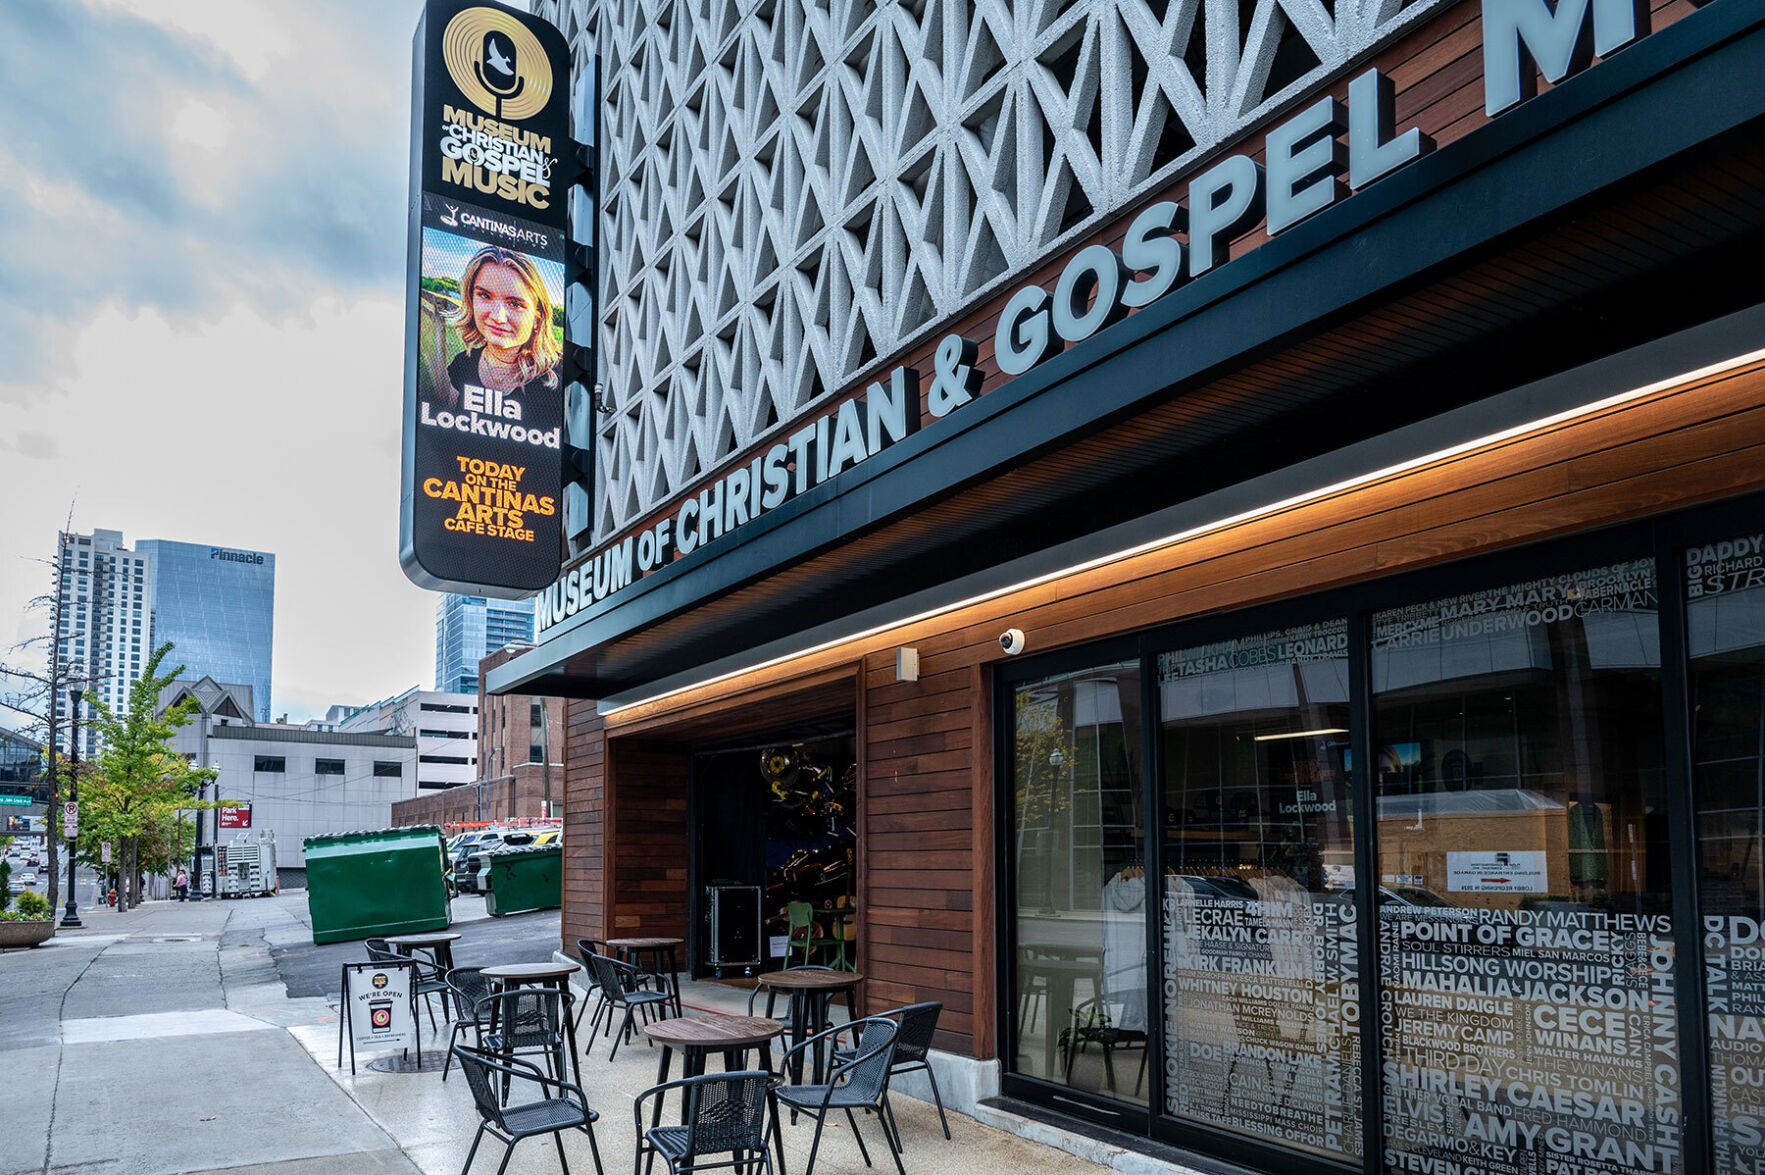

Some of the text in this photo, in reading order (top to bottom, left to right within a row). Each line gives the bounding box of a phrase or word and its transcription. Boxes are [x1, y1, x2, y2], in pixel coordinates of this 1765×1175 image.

[442, 104, 552, 153] MUSEUM
[449, 124, 544, 165] CHRISTIAN
[440, 136, 551, 188] GOSPEL
[442, 156, 551, 210] MUSIC
[535, 536, 633, 633] MUSEUM
[637, 518, 670, 571] OF
[676, 366, 907, 554] CHRISTIAN
[928, 334, 974, 418] &
[994, 67, 1420, 376] GOSPEL
[464, 384, 522, 421] Ella
[420, 401, 560, 449] Lockwood
[456, 455, 526, 481] TODAY
[423, 478, 555, 515] CANTINAS
[465, 474, 517, 491] ON THE
[456, 502, 524, 528] ARTS
[444, 518, 535, 542] CAFE STAGE
[211, 547, 264, 565] Pinnacle
[1686, 533, 1765, 566] DADDY
[1580, 568, 1651, 588] BROOKLYN
[1704, 555, 1763, 576] RICHARD
[1511, 566, 1609, 594] MIGHTY CLOUDS
[1580, 577, 1652, 600] TABERNACLE
[1687, 565, 1704, 598] BIG
[1440, 596, 1500, 619] MARY
[1505, 583, 1571, 608] MARY
[1574, 590, 1659, 618] CARMAN
[1371, 629, 1440, 651] CARRIE
[1441, 604, 1574, 640] UNDERWOOD
[1376, 616, 1440, 639] MERCYME
[1278, 633, 1348, 658] LEONARD
[1279, 800, 1337, 814] Lockwood
[1298, 790, 1318, 801] Ella
[1184, 908, 1244, 926] LECRAE
[1213, 899, 1244, 909] HARRIS
[1379, 905, 1478, 917] ANDREW PETERSON
[1395, 914, 1414, 922] ARE
[1184, 924, 1304, 945] JEKALYN CARR
[1326, 903, 1338, 960] SMITH
[1479, 908, 1672, 933] RANDY MATTHEWS
[1401, 921, 1610, 952] POINT OF GRACE
[1402, 940, 1511, 958] SOUL STIRRERS
[1221, 957, 1303, 979] FRANKLIN
[1313, 935, 1326, 995] BOBBY
[1392, 921, 1401, 989] RAINE NAOMI
[1402, 952, 1612, 985] HILLSONG WORSHIP
[1512, 948, 1611, 963] MIEL SAN MARCOS
[1610, 930, 1638, 989] RICKY SKAGGS
[1703, 916, 1729, 1013] DC TALK
[1338, 903, 1361, 1036] TOBYMAC
[1731, 971, 1740, 980] &
[359, 991, 381, 1001] WE'RE
[1178, 978, 1313, 1004] WHITNEY HOUSTON
[1379, 920, 1394, 1061] ANDRAE CROUCH
[1395, 990, 1514, 1016] LAUREN DAIGLE
[1402, 970, 1650, 1012] MAHALIA JACKSON
[1190, 1000, 1240, 1013] JONATHAN
[1242, 1005, 1314, 1023] MCREYNOLDS
[1395, 1006, 1514, 1030] WE THE KINGDOM
[1533, 1004, 1626, 1039] CECE
[1395, 1018, 1514, 1045] JEREMY CAMP
[1534, 1028, 1628, 1056] WINANS
[1629, 1014, 1642, 1057] CAIN
[1650, 934, 1680, 1148] JOHNNY CASH
[1189, 1042, 1222, 1062] DOE
[1223, 1041, 1322, 1069] BRANDON LAKE
[1402, 1035, 1461, 1052] BLACKWOOD
[1463, 1042, 1516, 1060] BROTHERS
[1402, 1045, 1461, 1070] THIRD
[1465, 1054, 1507, 1076] DAY
[1534, 1046, 1643, 1069] WALTER HAWKINS
[1710, 1040, 1762, 1054] AUDIO
[1165, 1020, 1178, 1113] SMOKIE
[1351, 1035, 1362, 1092] REBECCA
[1534, 1056, 1644, 1083] THE WINANS
[1230, 1071, 1262, 1090] CAIN
[1383, 1061, 1503, 1102] SHIRLEY
[1507, 1081, 1646, 1128] CAESAR
[1506, 1066, 1644, 1100] CHRIS TOMLIN
[1231, 1096, 1324, 1125] NEEDTOBREATHE
[1323, 1073, 1342, 1152] PETRA
[1383, 1085, 1513, 1117] GAITHER VOCAL BAND
[1383, 1095, 1445, 1124] ELVIS
[1712, 1064, 1730, 1137] FRANKLIN
[1232, 1117, 1324, 1148] BLESSING OFFOR
[1383, 1114, 1445, 1132] PRESLEY
[1514, 1106, 1648, 1142] FRED HAMMOND
[1383, 1123, 1469, 1153] DEGARMO
[1468, 1141, 1481, 1156] &
[1480, 1143, 1518, 1163] KEY
[1411, 1144, 1463, 1162] CLEVELAND
[1463, 1113, 1541, 1151] AMY
[1544, 1127, 1680, 1175] GRANT
[1384, 1149, 1461, 1175] STEVEN
[1462, 1155, 1488, 1168] KEITH
[1488, 1160, 1519, 1175] GREEN
[1546, 1151, 1576, 1164] SISTER
[1577, 1156, 1618, 1172] ROSETTA
